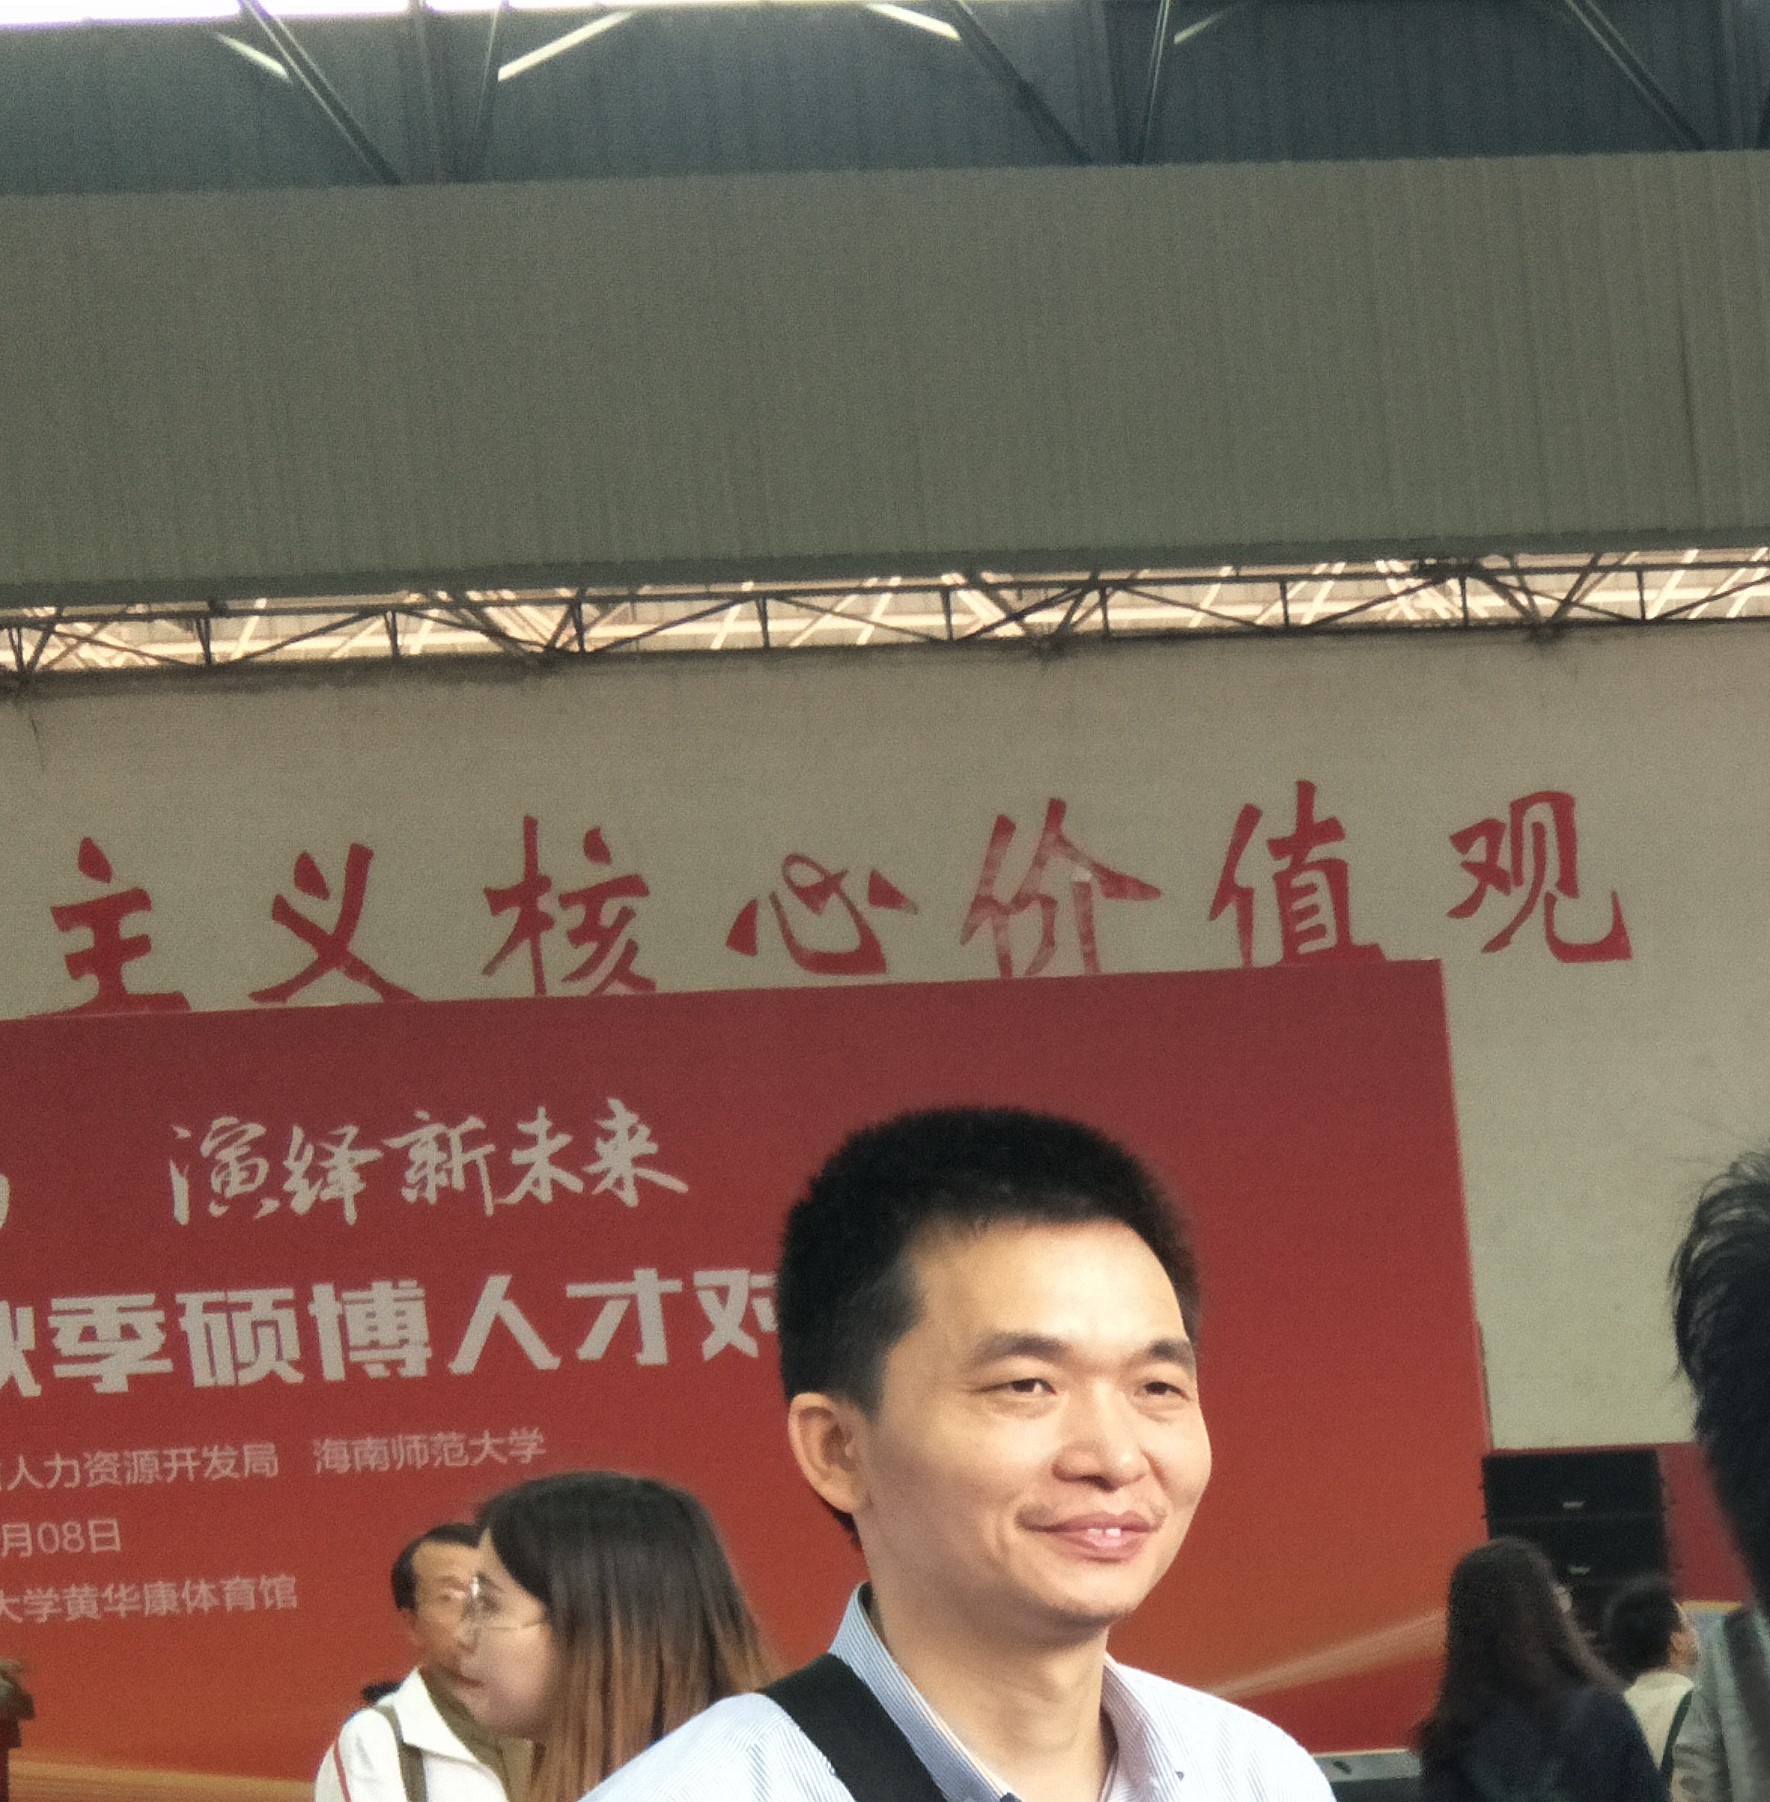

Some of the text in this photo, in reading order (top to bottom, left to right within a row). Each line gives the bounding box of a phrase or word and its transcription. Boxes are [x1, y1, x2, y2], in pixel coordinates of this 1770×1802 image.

[26, 778, 1633, 1019] 主义核心价值观
[169, 1098, 689, 1225] 演绎新未来
[0, 1426, 546, 1491] 人力资源开发局 海南师范大学
[1, 1517, 122, 1558] 月08日
